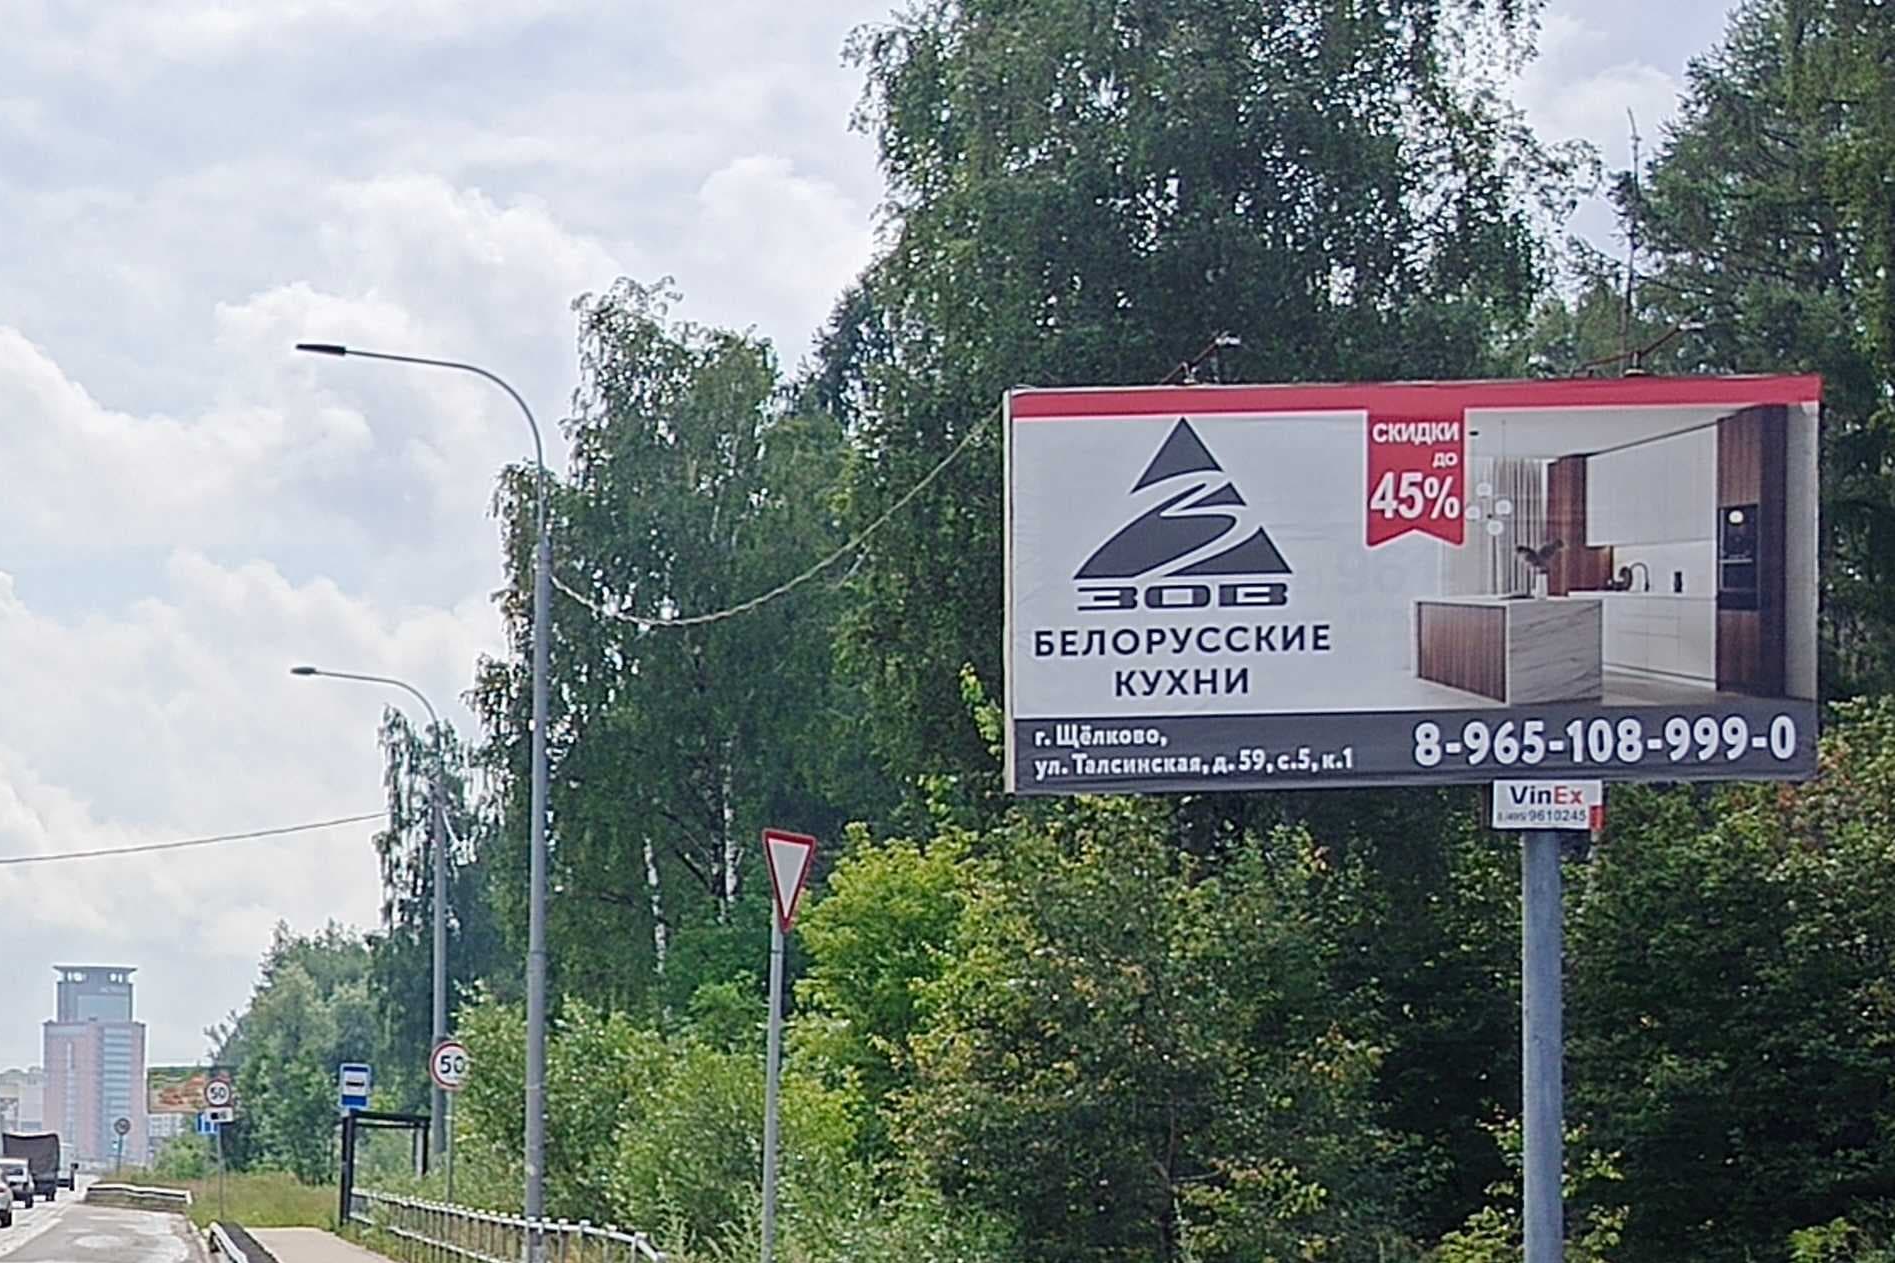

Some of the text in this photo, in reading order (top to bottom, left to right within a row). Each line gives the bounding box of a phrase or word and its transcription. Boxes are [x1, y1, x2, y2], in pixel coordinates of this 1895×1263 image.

[1372, 422, 1460, 445] СКИДКИ
[1370, 471, 1460, 519] 45%
[1077, 583, 1288, 611] ЗОВ
[1034, 624, 1331, 656] БЕЛОРУССКИЕ
[1115, 667, 1249, 696] КУХНИ
[1035, 724, 1168, 748] г. Щёлково,
[1414, 715, 1796, 766] 8-965-108-999-0
[1035, 758, 1068, 780] ул.
[1510, 786, 1583, 804] VinEx
[440, 1055, 464, 1074] 50
[210, 1086, 226, 1099] 50
